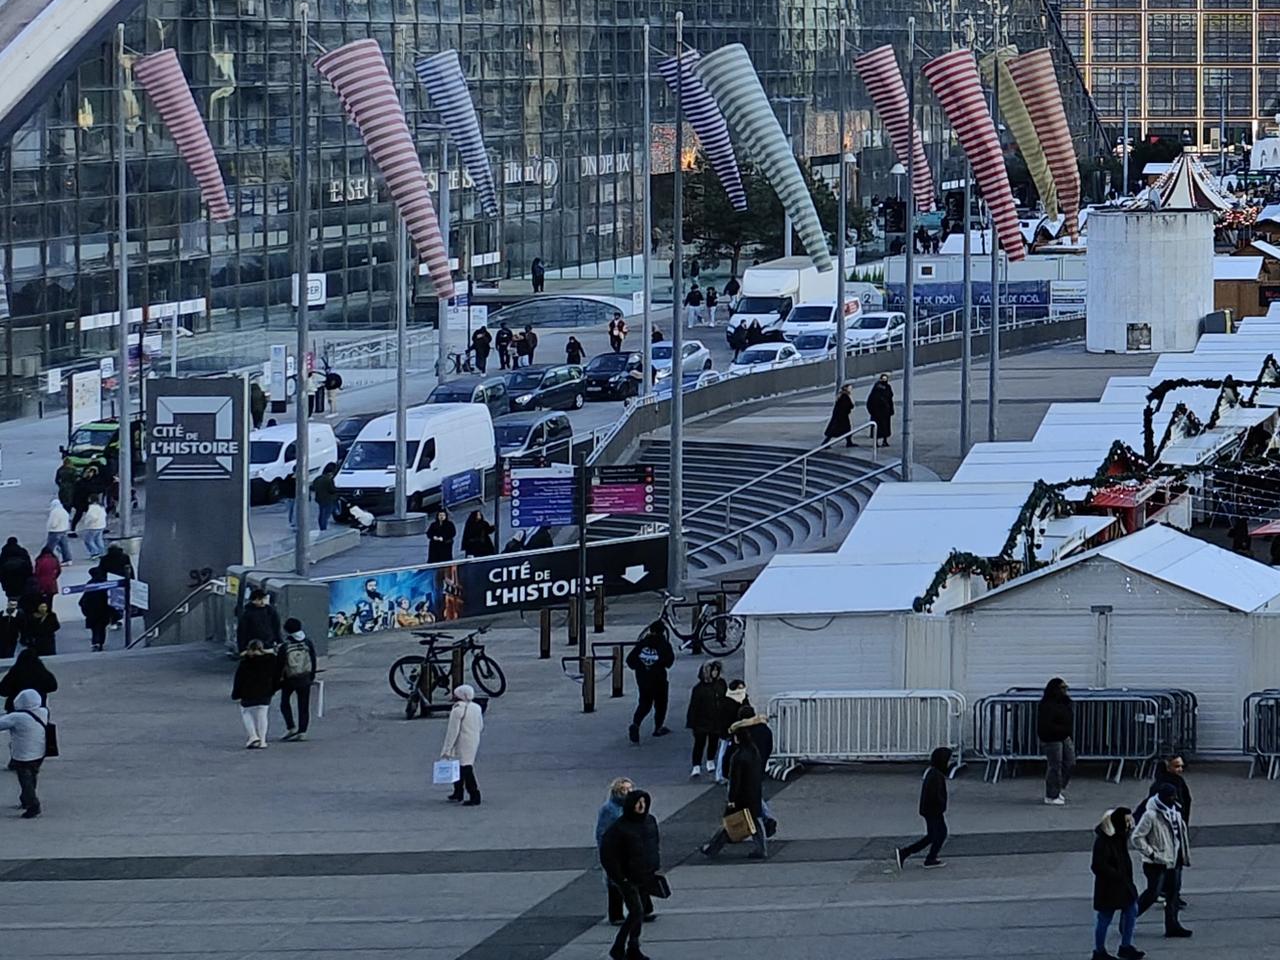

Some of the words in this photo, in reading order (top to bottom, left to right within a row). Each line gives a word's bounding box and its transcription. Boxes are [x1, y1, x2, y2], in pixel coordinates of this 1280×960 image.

[864, 294, 871, 304] 2
[153, 424, 184, 437] CITÉ
[186, 432, 198, 440] DE
[150, 441, 239, 454] L'HISTOIRE
[488, 561, 531, 583] CITÉ
[534, 569, 551, 582] DE
